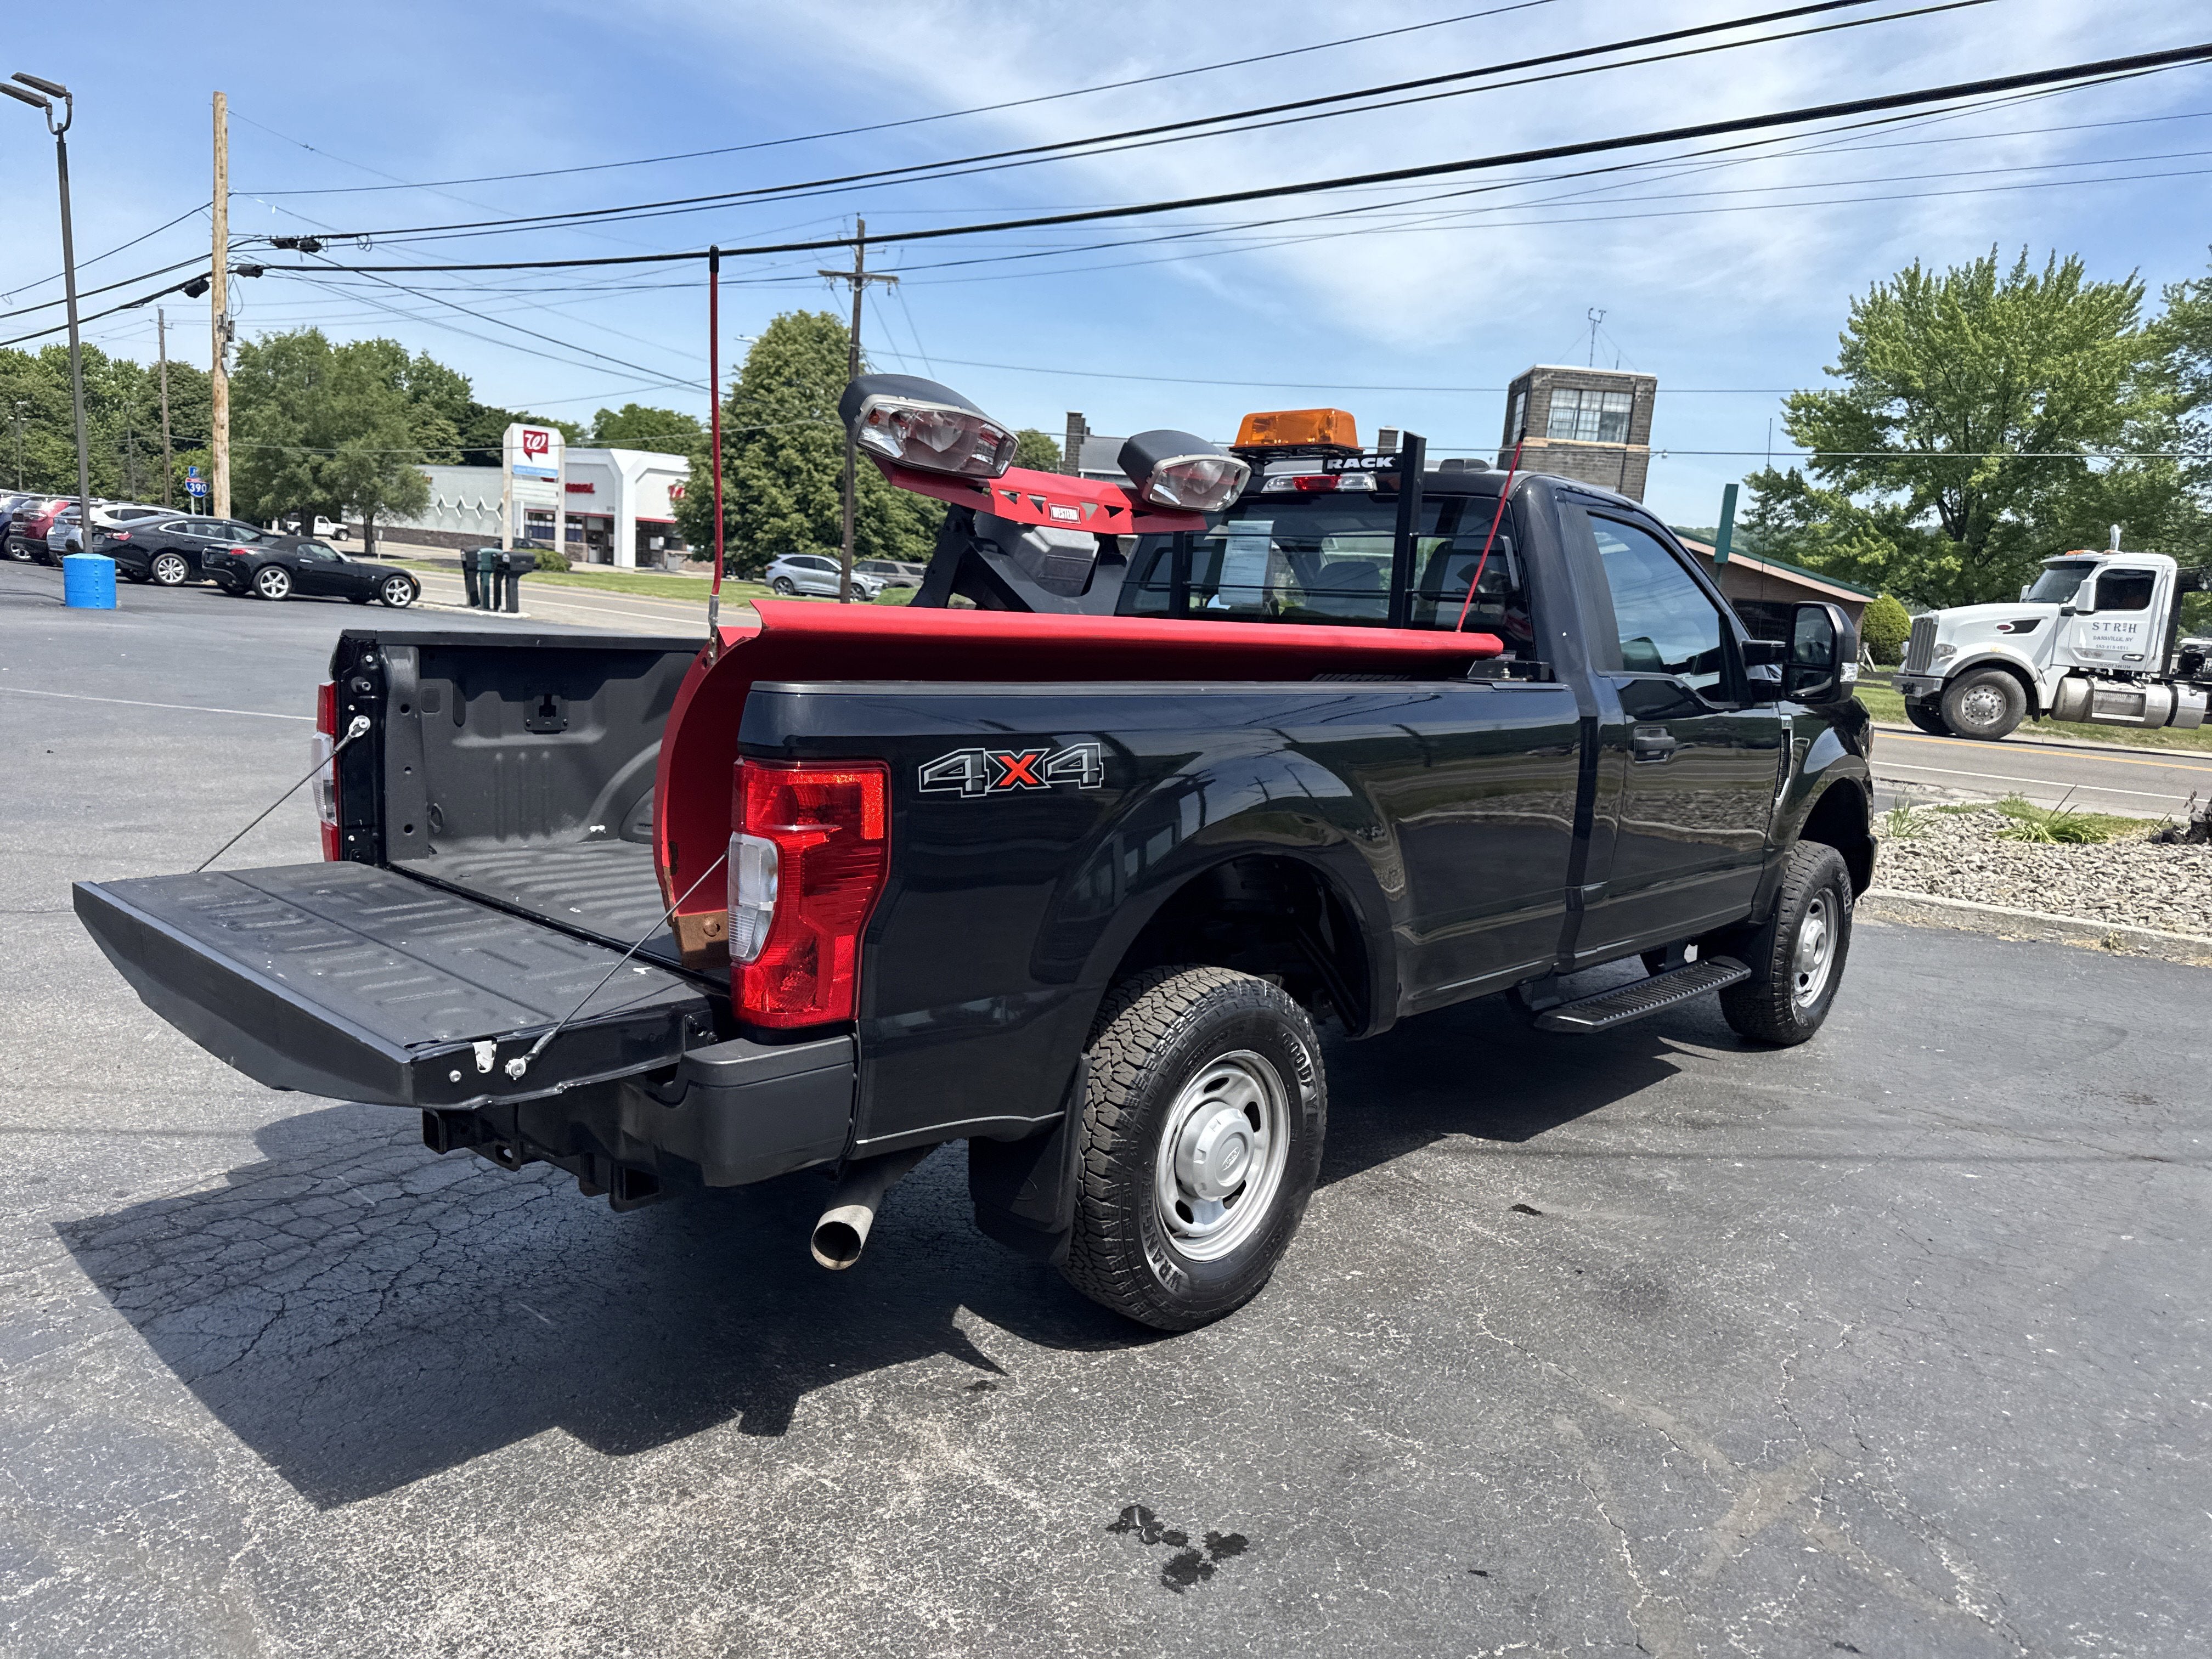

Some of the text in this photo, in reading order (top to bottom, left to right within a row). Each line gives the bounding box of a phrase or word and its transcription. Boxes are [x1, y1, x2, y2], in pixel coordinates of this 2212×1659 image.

[1327, 456, 1394, 469] RACK
[189, 483, 207, 493] 390
[1052, 506, 1078, 521] WESTERN
[1282, 1032, 1318, 1161] GOODYEAR
[1141, 1161, 1183, 1291] WRANGLER
